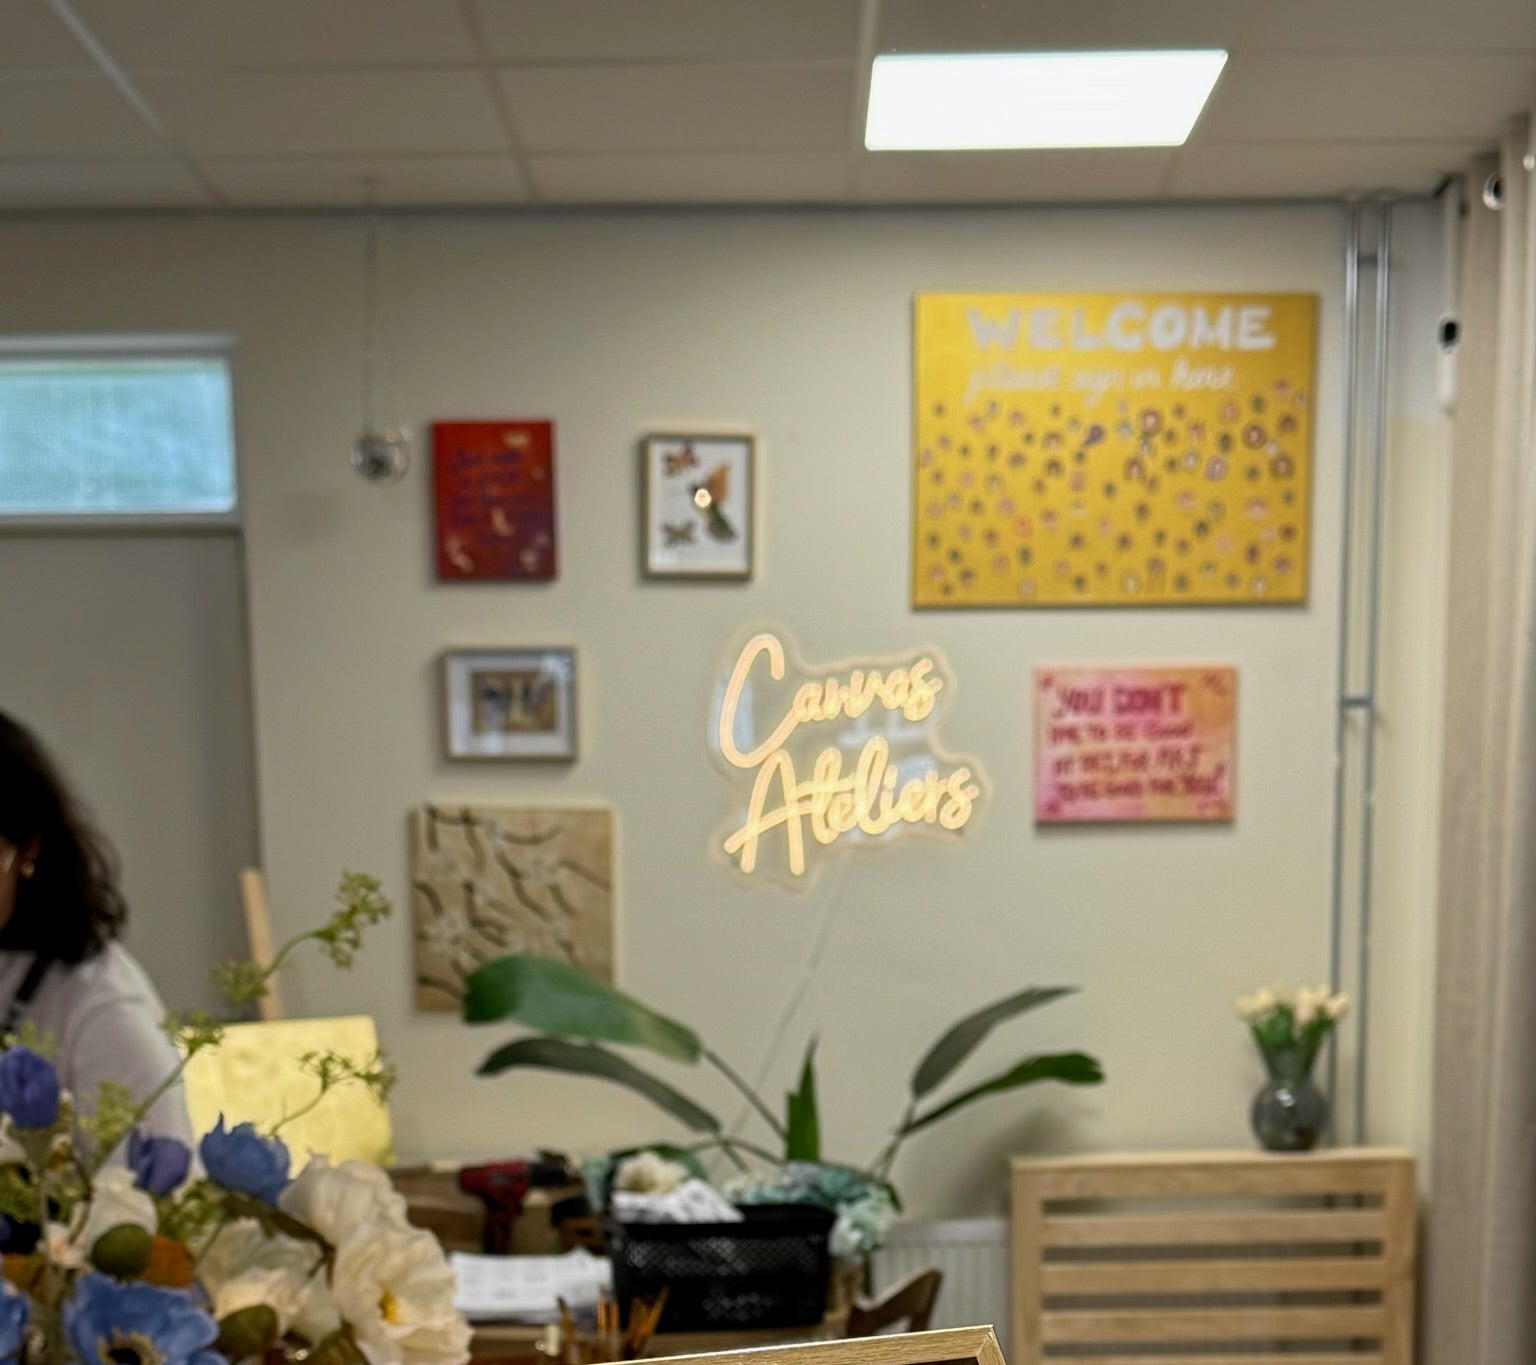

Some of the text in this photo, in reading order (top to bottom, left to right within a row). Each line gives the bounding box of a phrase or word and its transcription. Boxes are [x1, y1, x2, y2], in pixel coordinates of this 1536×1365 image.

[966, 303, 1276, 353] WELCOME
[719, 633, 980, 876] Canvas Ateliers
